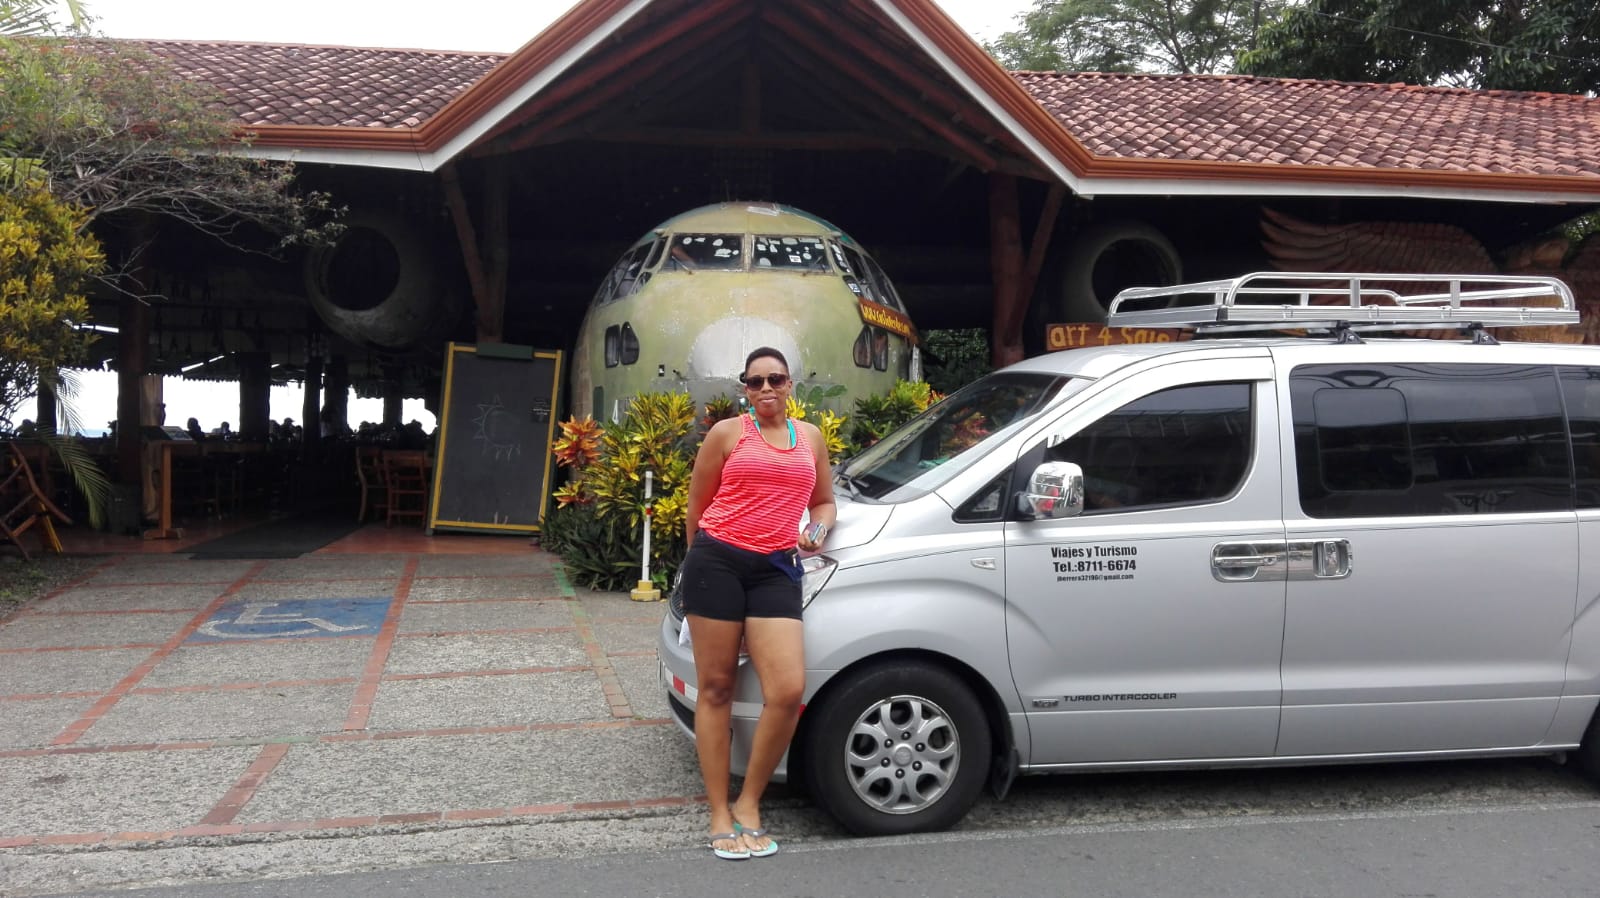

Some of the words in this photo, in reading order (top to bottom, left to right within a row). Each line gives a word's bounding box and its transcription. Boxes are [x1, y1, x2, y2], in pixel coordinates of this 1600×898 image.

[1097, 327, 1112, 346] 4
[1051, 547, 1084, 558] Viajes
[1086, 547, 1092, 558] y
[1094, 546, 1137, 556] Turismo
[1053, 559, 1136, 572] Tel.:8711-6674
[1102, 693, 1177, 701] INTERCOOLER
